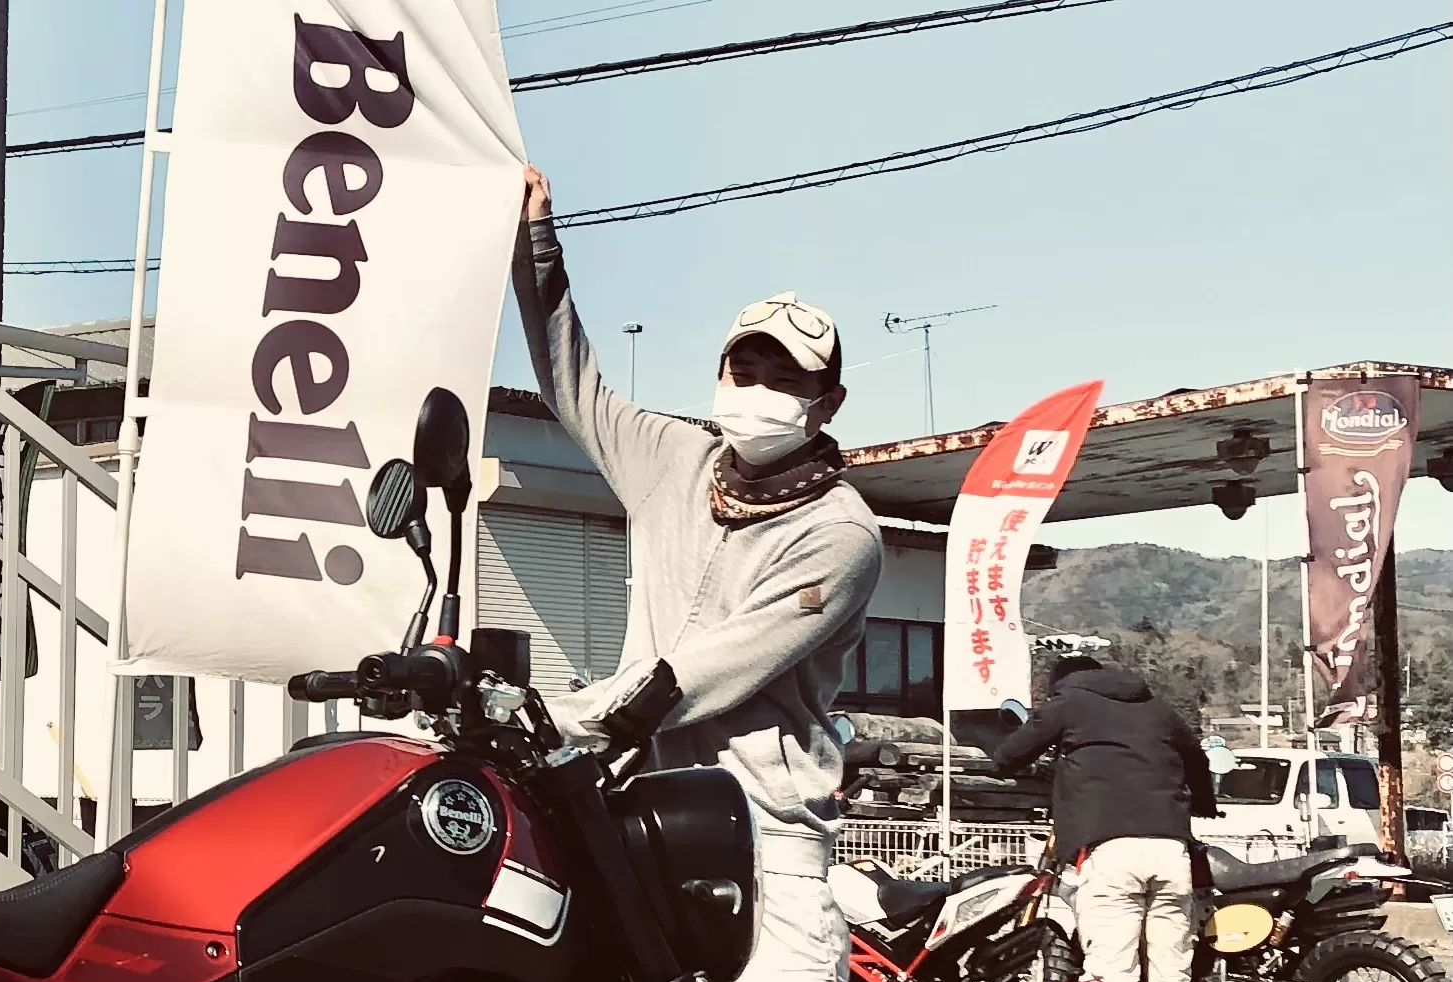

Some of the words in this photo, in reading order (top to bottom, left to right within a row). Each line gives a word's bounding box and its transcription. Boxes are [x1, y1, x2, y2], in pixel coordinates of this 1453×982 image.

[234, 12, 416, 587] Benelli
[1320, 405, 1407, 437] Mondial
[988, 508, 1030, 631] 使えます。
[439, 805, 483, 824] Benelli
